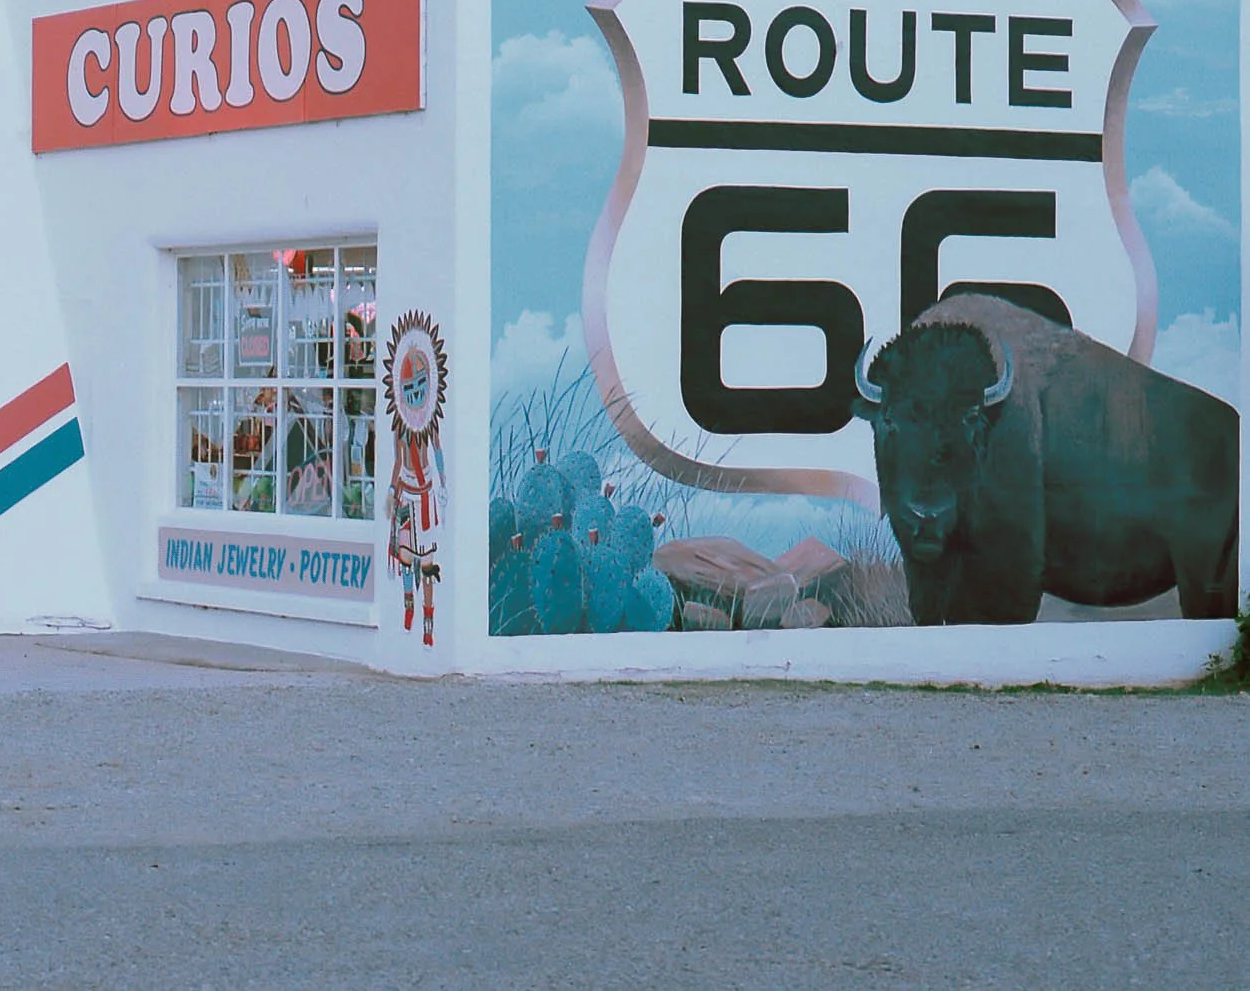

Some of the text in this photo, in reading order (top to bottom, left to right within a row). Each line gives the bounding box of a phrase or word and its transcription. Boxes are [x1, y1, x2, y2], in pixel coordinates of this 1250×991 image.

[681, 1, 1075, 109] ROUTE
[165, 537, 371, 589] INDIAN JEWELRY POTTERY
